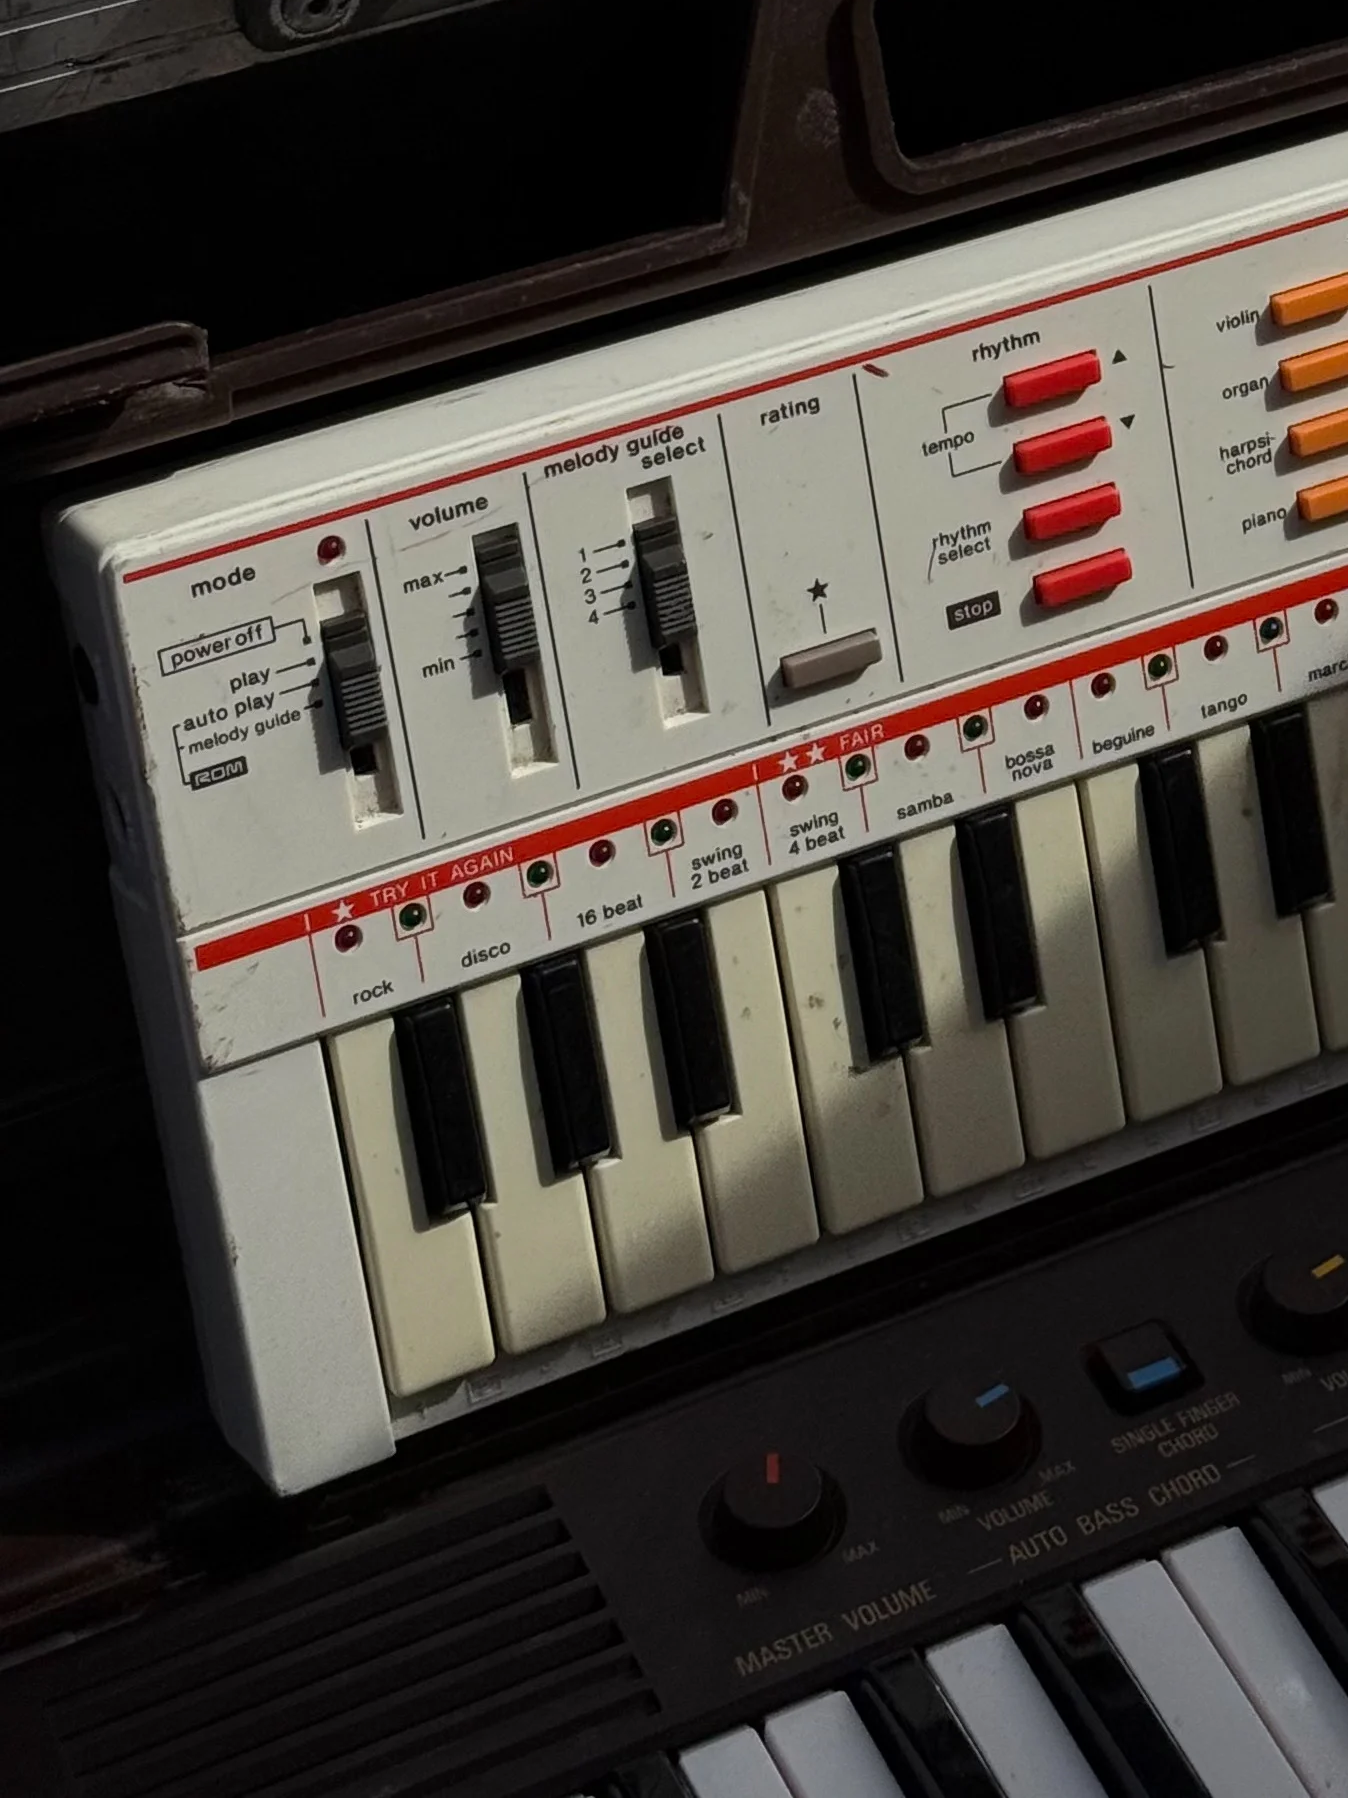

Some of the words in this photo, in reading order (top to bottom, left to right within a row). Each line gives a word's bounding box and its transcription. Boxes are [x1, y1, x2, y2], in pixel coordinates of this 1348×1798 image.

[1216, 310, 1260, 333] violin
[972, 329, 1041, 363] rhythm
[1222, 375, 1269, 401] organ
[760, 390, 820, 425] rating
[543, 446, 620, 479] melody
[626, 424, 685, 456] guide
[641, 437, 706, 470] select
[921, 430, 975, 457] tempo
[1219, 432, 1275, 462] harpsi-
[1226, 449, 1272, 476] chord
[409, 494, 490, 531] volume
[1242, 506, 1287, 533] piano
[932, 520, 992, 549] rhythm
[578, 547, 586, 562] 1
[938, 536, 992, 566] select
[190, 564, 257, 598] mode
[402, 571, 445, 594] max
[580, 567, 591, 583] 2
[584, 588, 596, 604] 3
[588, 609, 599, 624] 4
[953, 598, 994, 624] stop
[171, 638, 232, 671] power
[235, 624, 264, 649] off
[229, 667, 271, 692] play
[421, 657, 456, 679] min
[183, 703, 231, 733] auto
[234, 691, 276, 717] play
[1201, 693, 1249, 721] tango
[187, 724, 249, 755] melody
[253, 707, 301, 738] guide
[839, 723, 885, 750] FAIR
[1092, 724, 1156, 755] beguine
[1005, 743, 1055, 769] bossa
[1012, 759, 1053, 782] nova
[194, 760, 245, 786] ROM
[897, 791, 954, 820] samba
[789, 810, 839, 836] swing
[789, 839, 799, 855] 4
[804, 826, 845, 850] beat
[692, 842, 743, 871] swing
[371, 880, 410, 904] TRY
[420, 870, 439, 890] IT
[450, 846, 514, 880] AGAIN
[691, 873, 704, 890] 2
[707, 858, 750, 883] beat
[577, 908, 599, 927] 16
[603, 893, 644, 921] beat
[461, 941, 511, 968] disco
[351, 979, 394, 1005] rock
[1111, 1416, 1175, 1453] SINGLE
[1176, 1392, 1240, 1428] FINGER
[1157, 1423, 1219, 1457] CHORD
[976, 1489, 1055, 1532] VOLUME
[1008, 1526, 1068, 1565] AUTO
[1076, 1497, 1139, 1537] BASS
[1148, 1463, 1221, 1504] CHORD
[735, 1622, 832, 1677] MASTER
[841, 1579, 937, 1631] VOLUME
